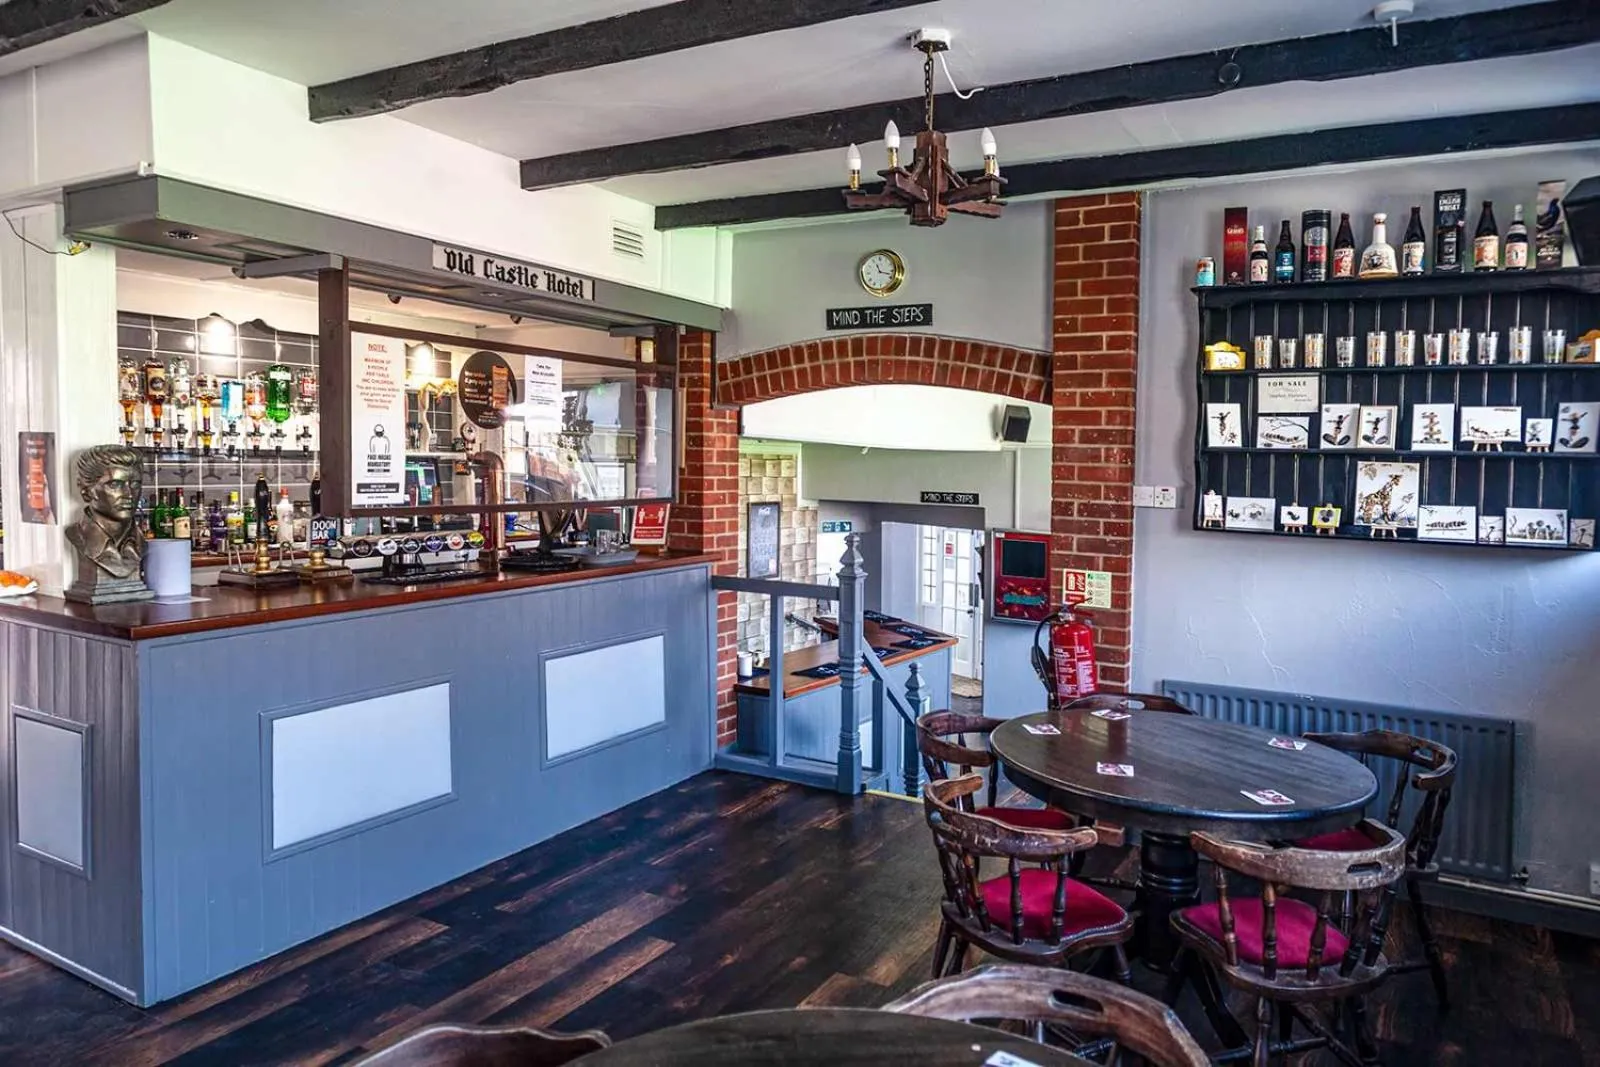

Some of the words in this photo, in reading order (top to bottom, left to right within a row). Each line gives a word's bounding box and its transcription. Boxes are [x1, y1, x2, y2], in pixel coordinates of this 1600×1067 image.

[444, 248, 475, 276] Old
[483, 258, 538, 288] Castle
[544, 270, 584, 299] Hotel
[832, 310, 860, 326] MIND
[864, 308, 887, 324] THE
[891, 306, 924, 323] STEPS
[924, 493, 941, 502] MIND
[942, 493, 955, 503] THE
[955, 494, 974, 503] STEPS
[312, 530, 329, 540] BAR
